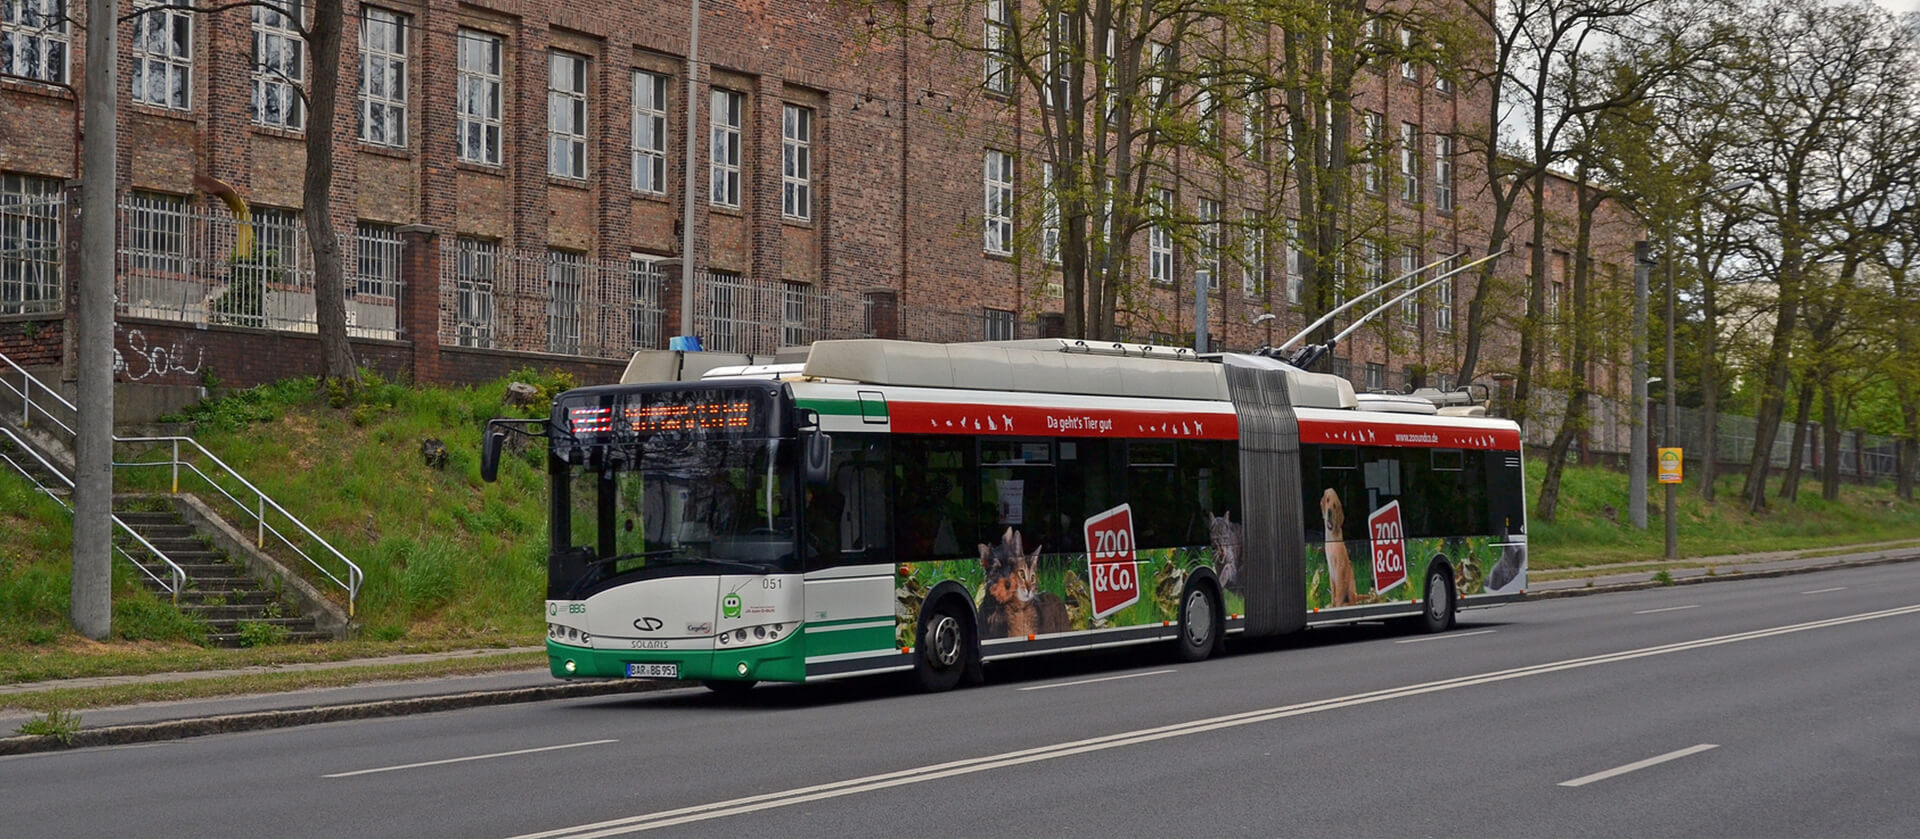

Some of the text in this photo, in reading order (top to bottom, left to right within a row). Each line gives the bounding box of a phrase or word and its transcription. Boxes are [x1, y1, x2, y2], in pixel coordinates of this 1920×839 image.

[1047, 416, 1112, 433] Da geht's Tier gut
[1376, 549, 1403, 573] &Co.
[1095, 563, 1133, 592] &Co.
[762, 578, 782, 589] 051
[569, 603, 586, 614] BBG
[631, 640, 669, 649] SOLARIS
[631, 665, 677, 676] BAR BG 951
